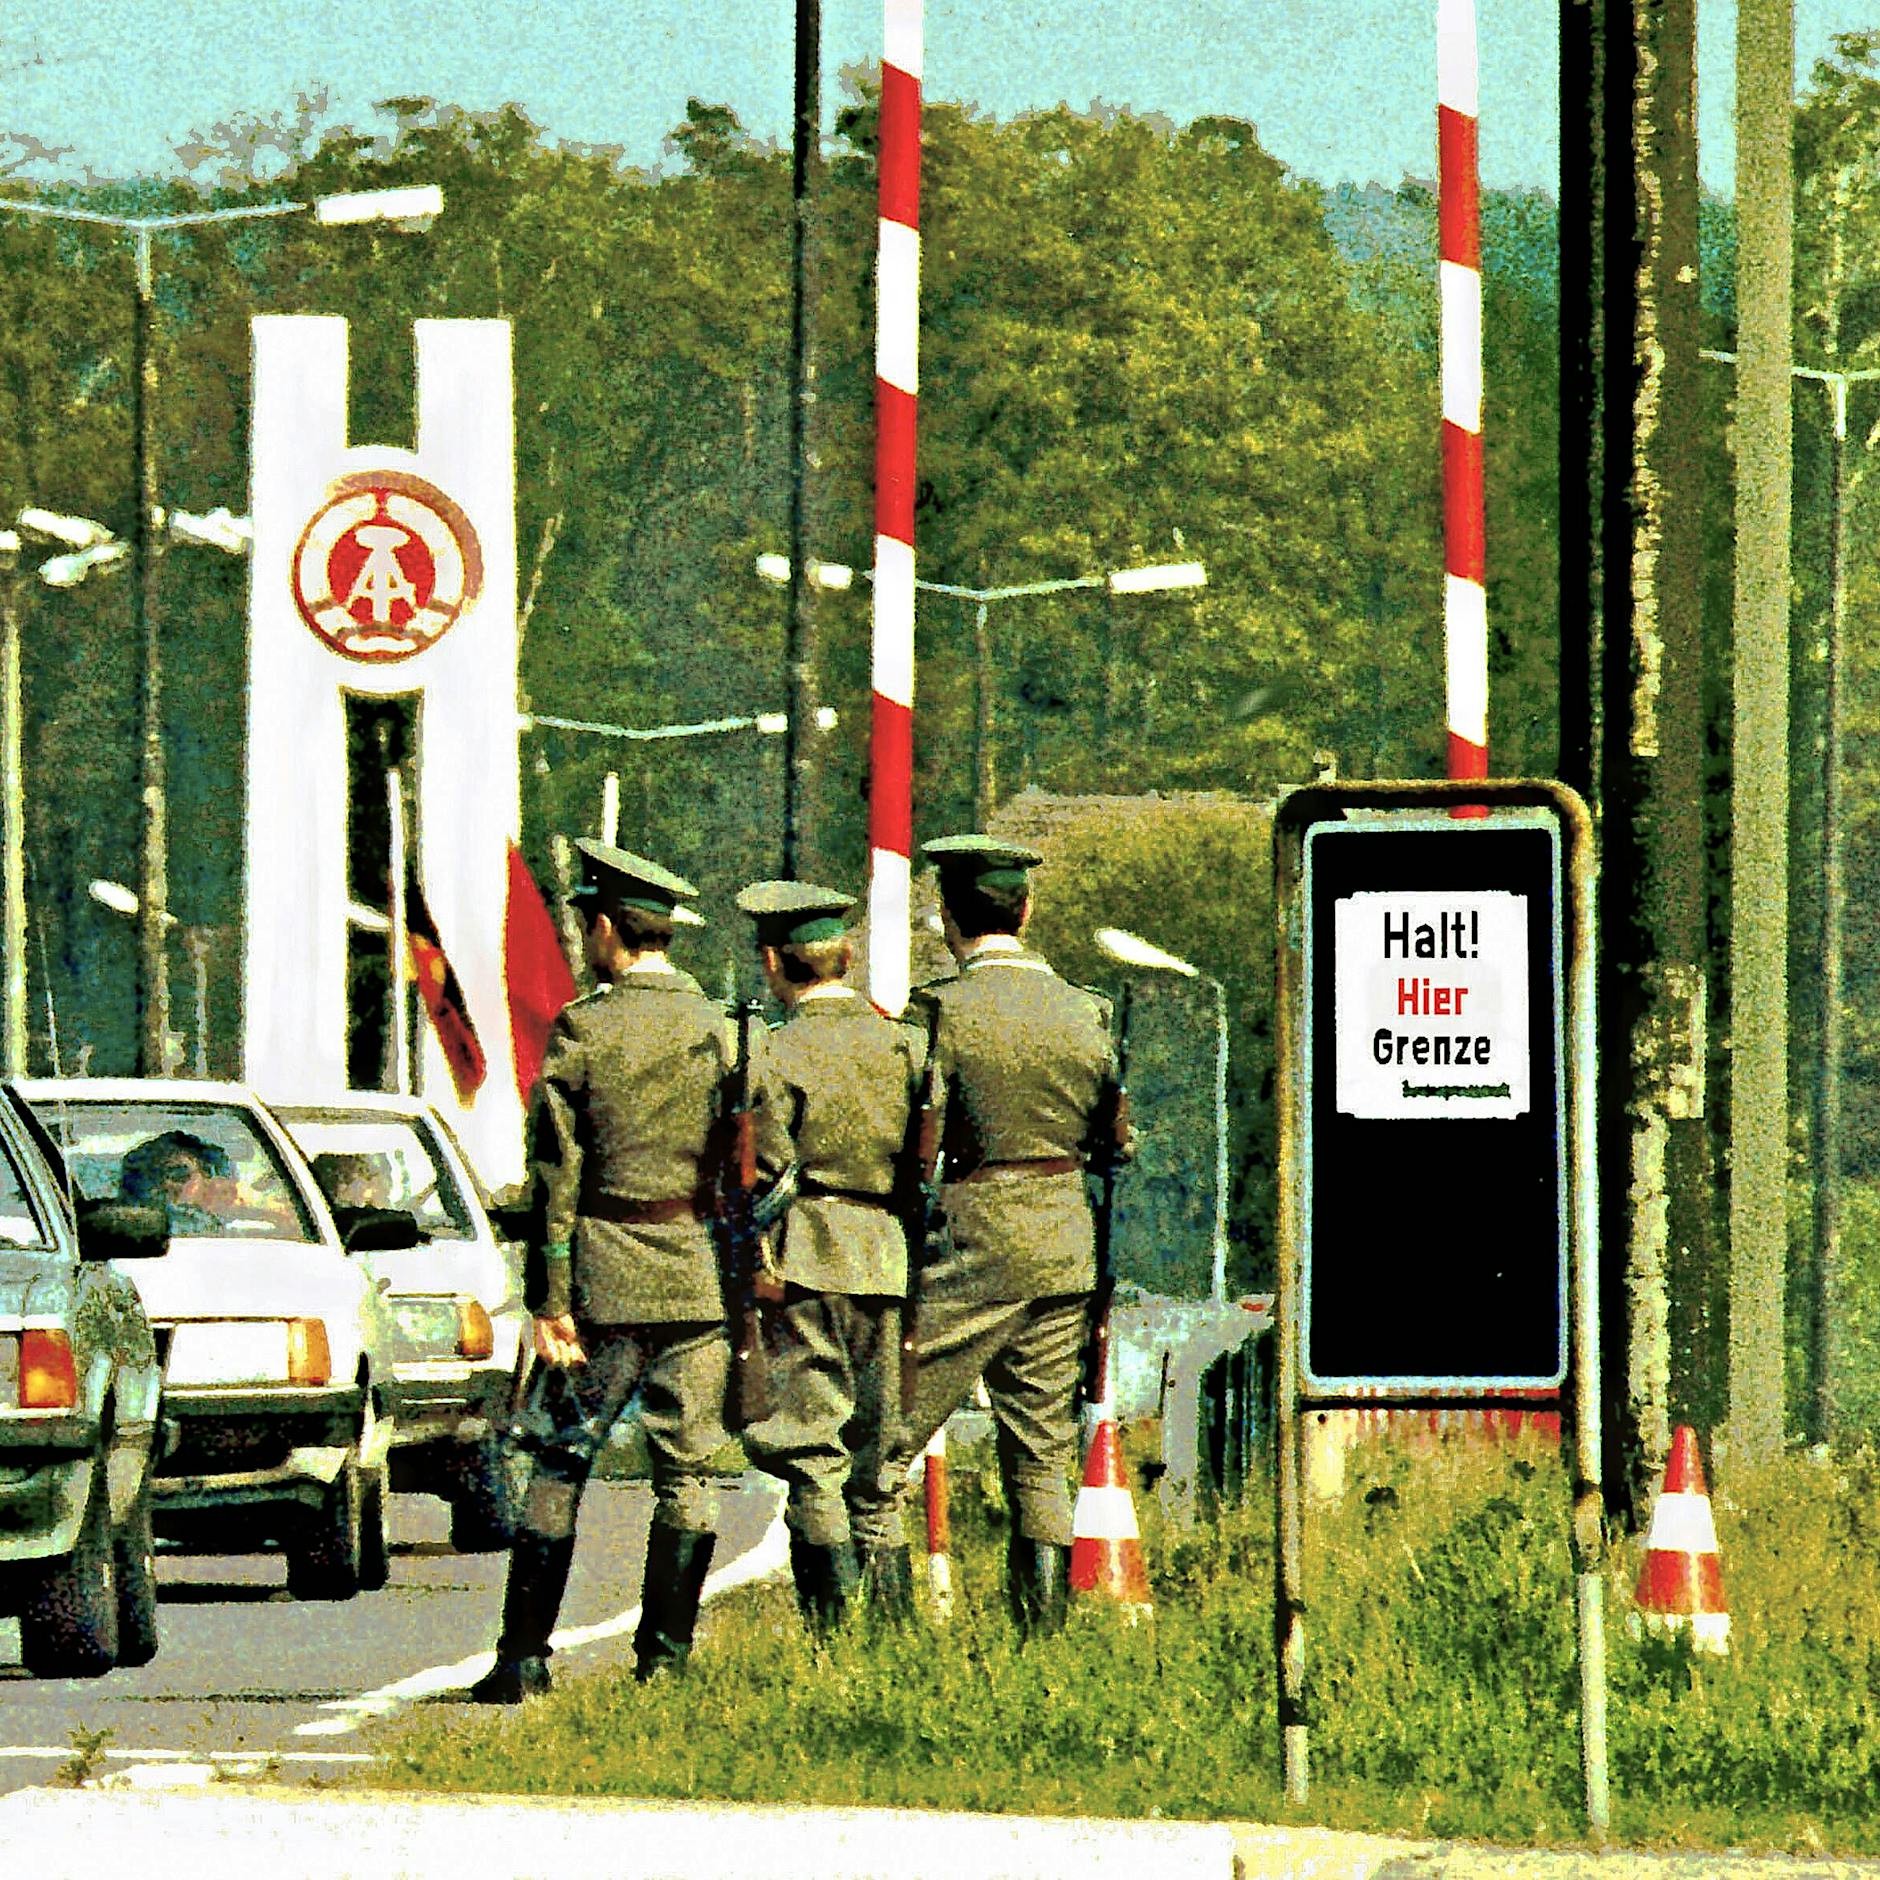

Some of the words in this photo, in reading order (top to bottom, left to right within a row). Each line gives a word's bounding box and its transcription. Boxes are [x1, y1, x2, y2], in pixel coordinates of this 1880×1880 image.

[1384, 911, 1479, 959] Halt!
[1398, 977, 1469, 1016] Hier
[1373, 1028, 1491, 1065] Grenze
